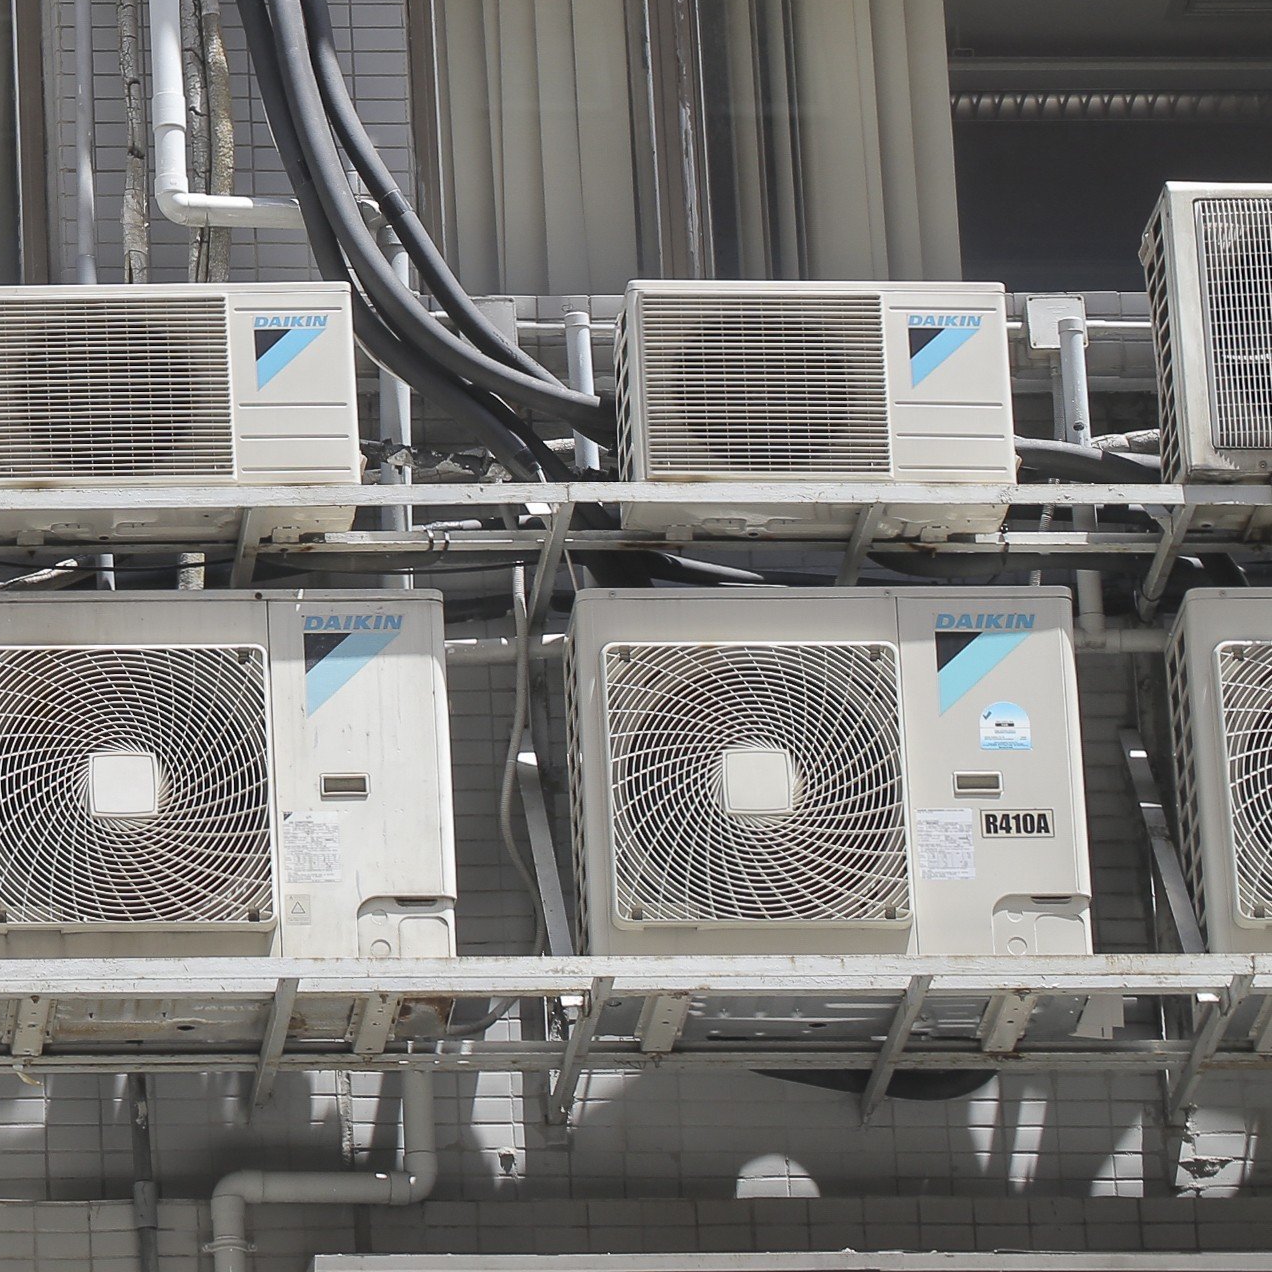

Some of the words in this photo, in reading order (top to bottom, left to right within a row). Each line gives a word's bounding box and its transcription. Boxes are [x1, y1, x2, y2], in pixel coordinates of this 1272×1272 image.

[254, 315, 328, 327] DAIKIN
[908, 315, 982, 327] DAIKIN
[304, 615, 403, 630] DAIKIN
[936, 613, 1036, 629] DAIKIN
[985, 813, 1051, 834] R410A
